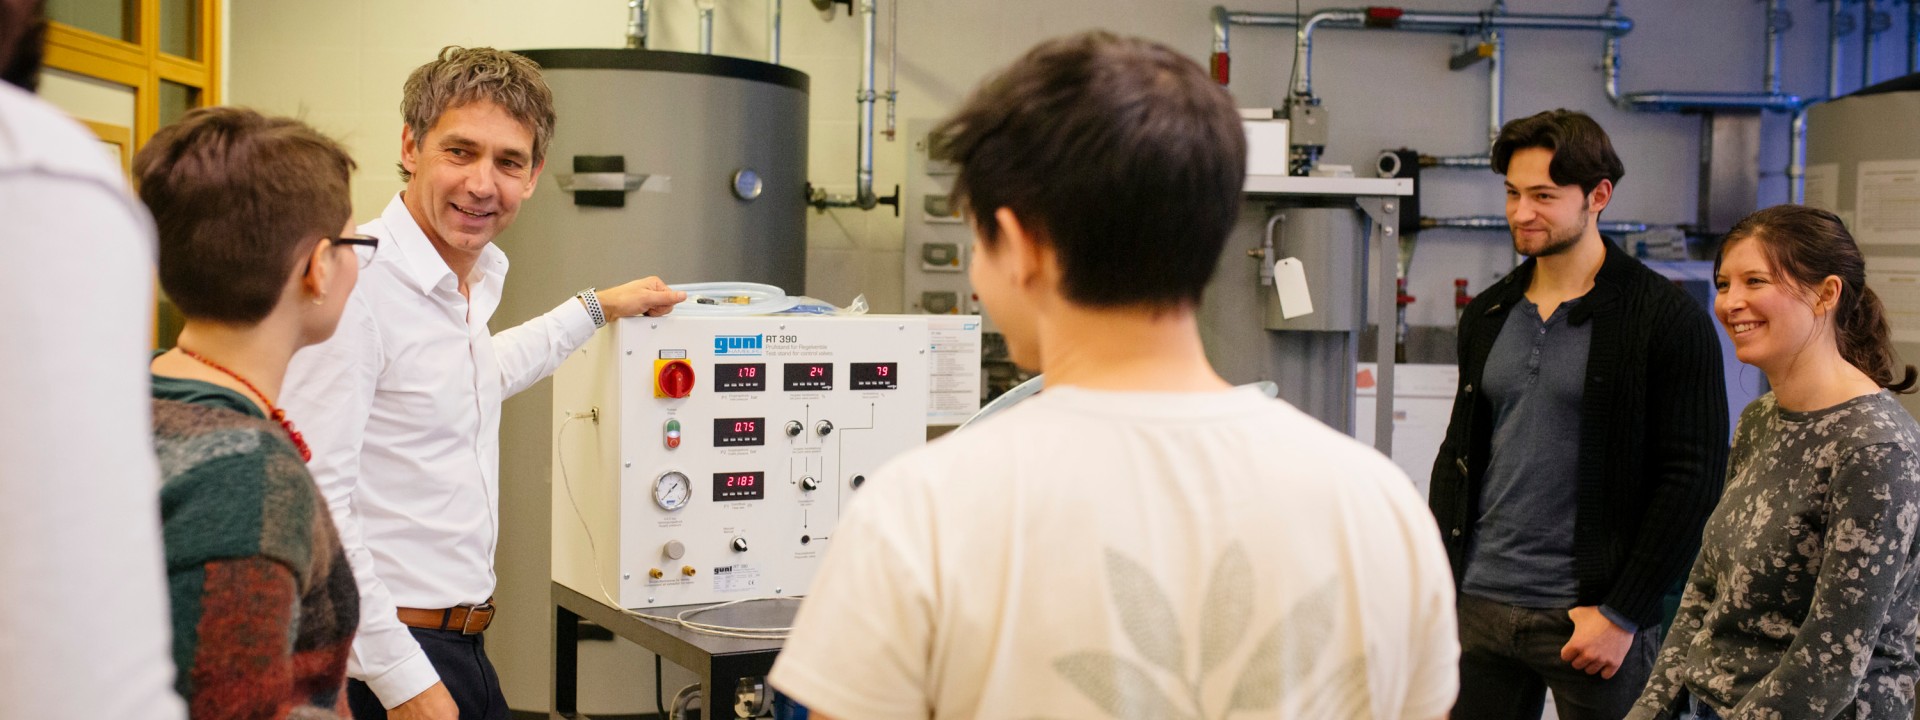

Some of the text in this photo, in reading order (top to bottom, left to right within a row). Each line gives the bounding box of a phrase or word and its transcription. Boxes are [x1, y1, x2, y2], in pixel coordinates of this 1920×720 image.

[714, 333, 762, 353] gunt
[766, 335, 797, 343] RT 390
[810, 367, 823, 377] 24
[877, 366, 888, 376] 79
[727, 476, 754, 486] 2183
